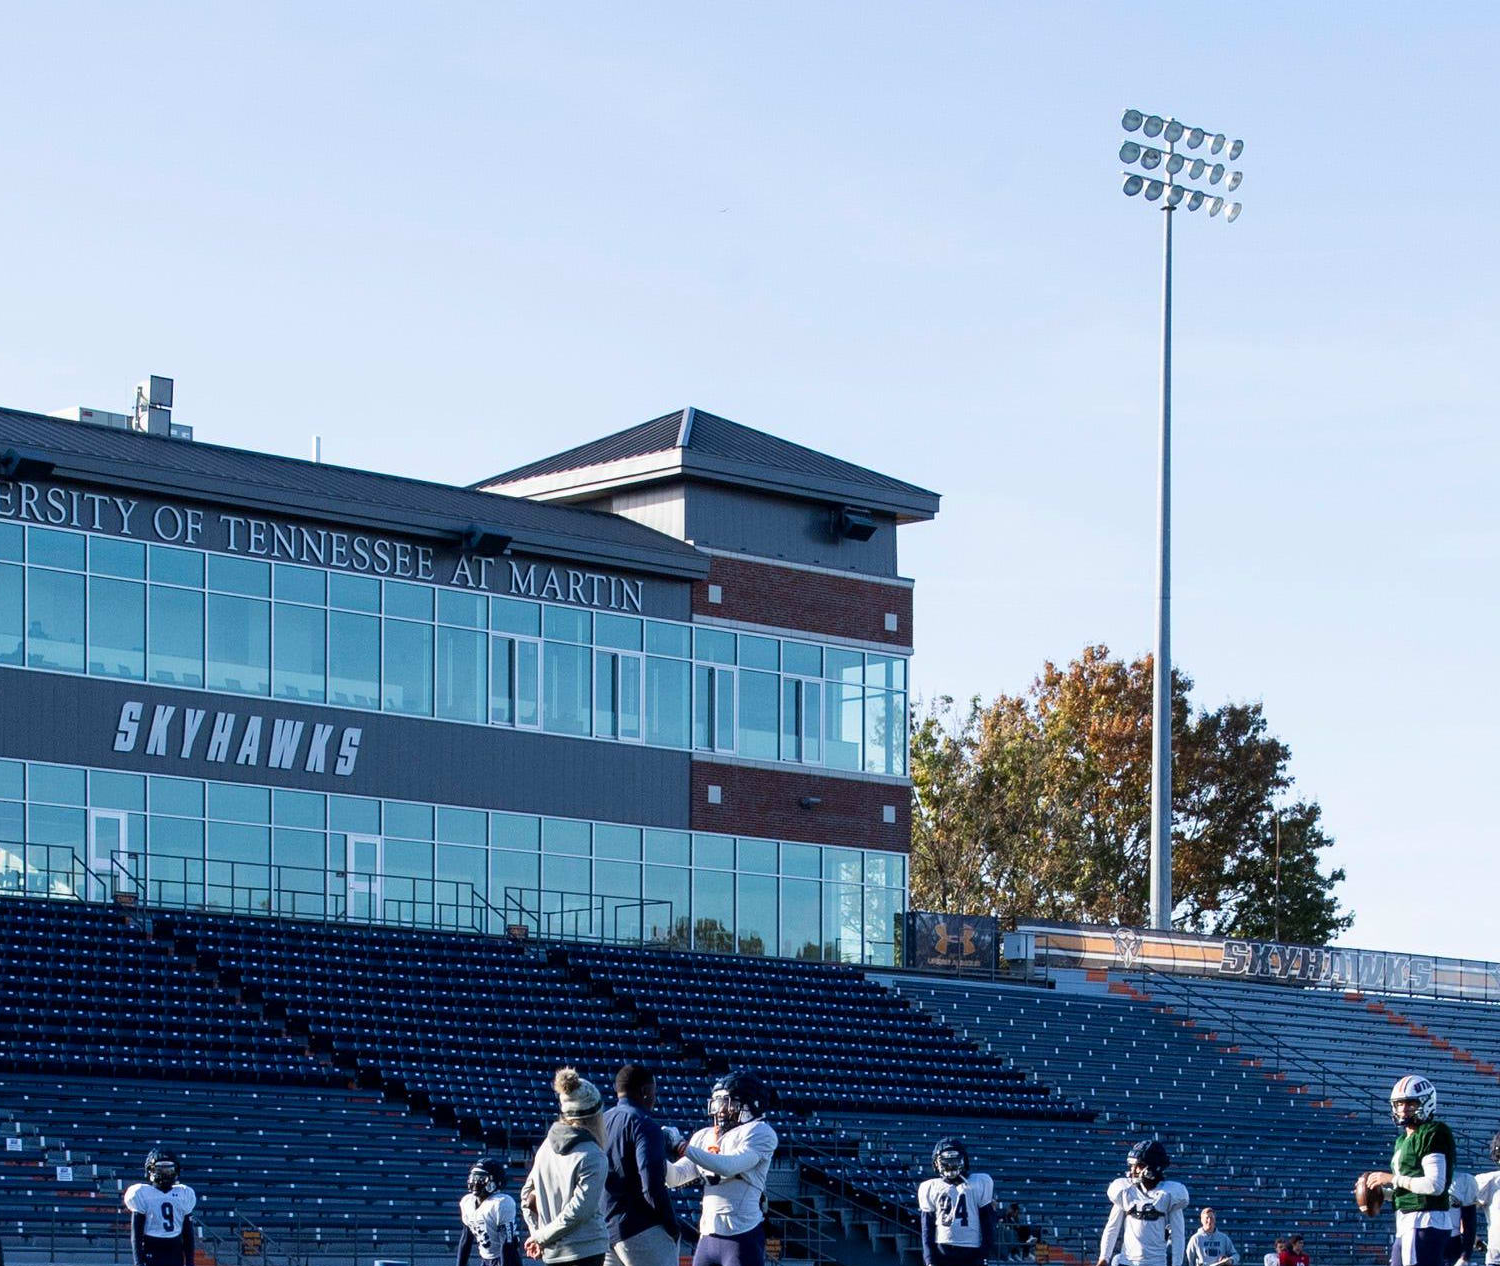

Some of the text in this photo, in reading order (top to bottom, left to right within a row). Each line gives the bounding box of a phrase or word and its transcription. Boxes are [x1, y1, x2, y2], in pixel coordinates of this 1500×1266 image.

[153, 505, 203, 544] OF
[219, 515, 435, 581] TENNESSEE
[450, 554, 495, 590] AT
[508, 560, 644, 613] MARTIN
[113, 701, 363, 776] SKYHAWKS
[1218, 940, 1435, 992] SKYHAWKS
[160, 1202, 174, 1232] 9
